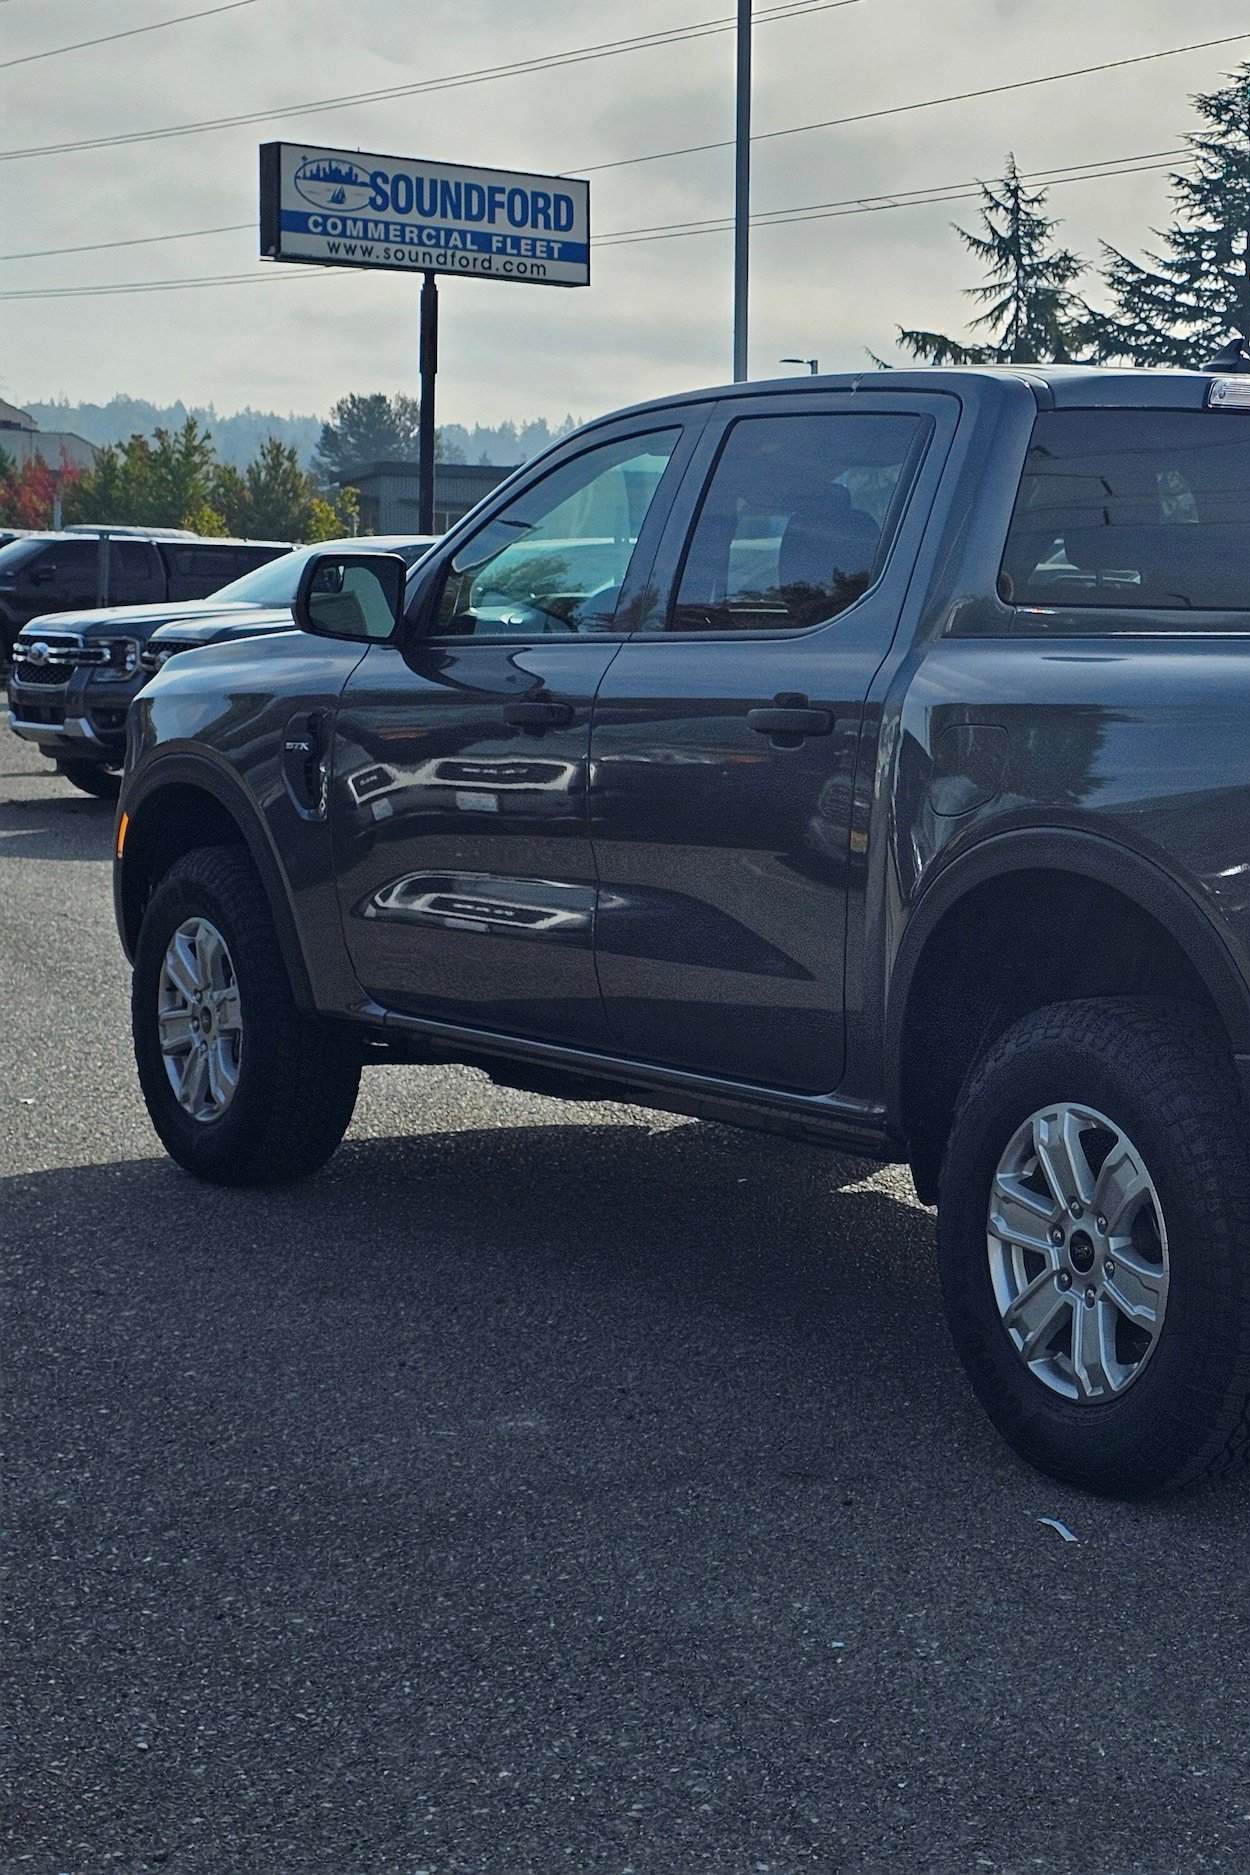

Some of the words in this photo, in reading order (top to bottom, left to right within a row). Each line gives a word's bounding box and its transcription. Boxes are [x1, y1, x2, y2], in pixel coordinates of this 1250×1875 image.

[368, 170, 574, 232] SOUNDFORD
[307, 215, 478, 250] COMMERCIAL
[491, 235, 562, 259] FLEET
[327, 241, 547, 277] www.soundford.com
[285, 742, 309, 750] STX
